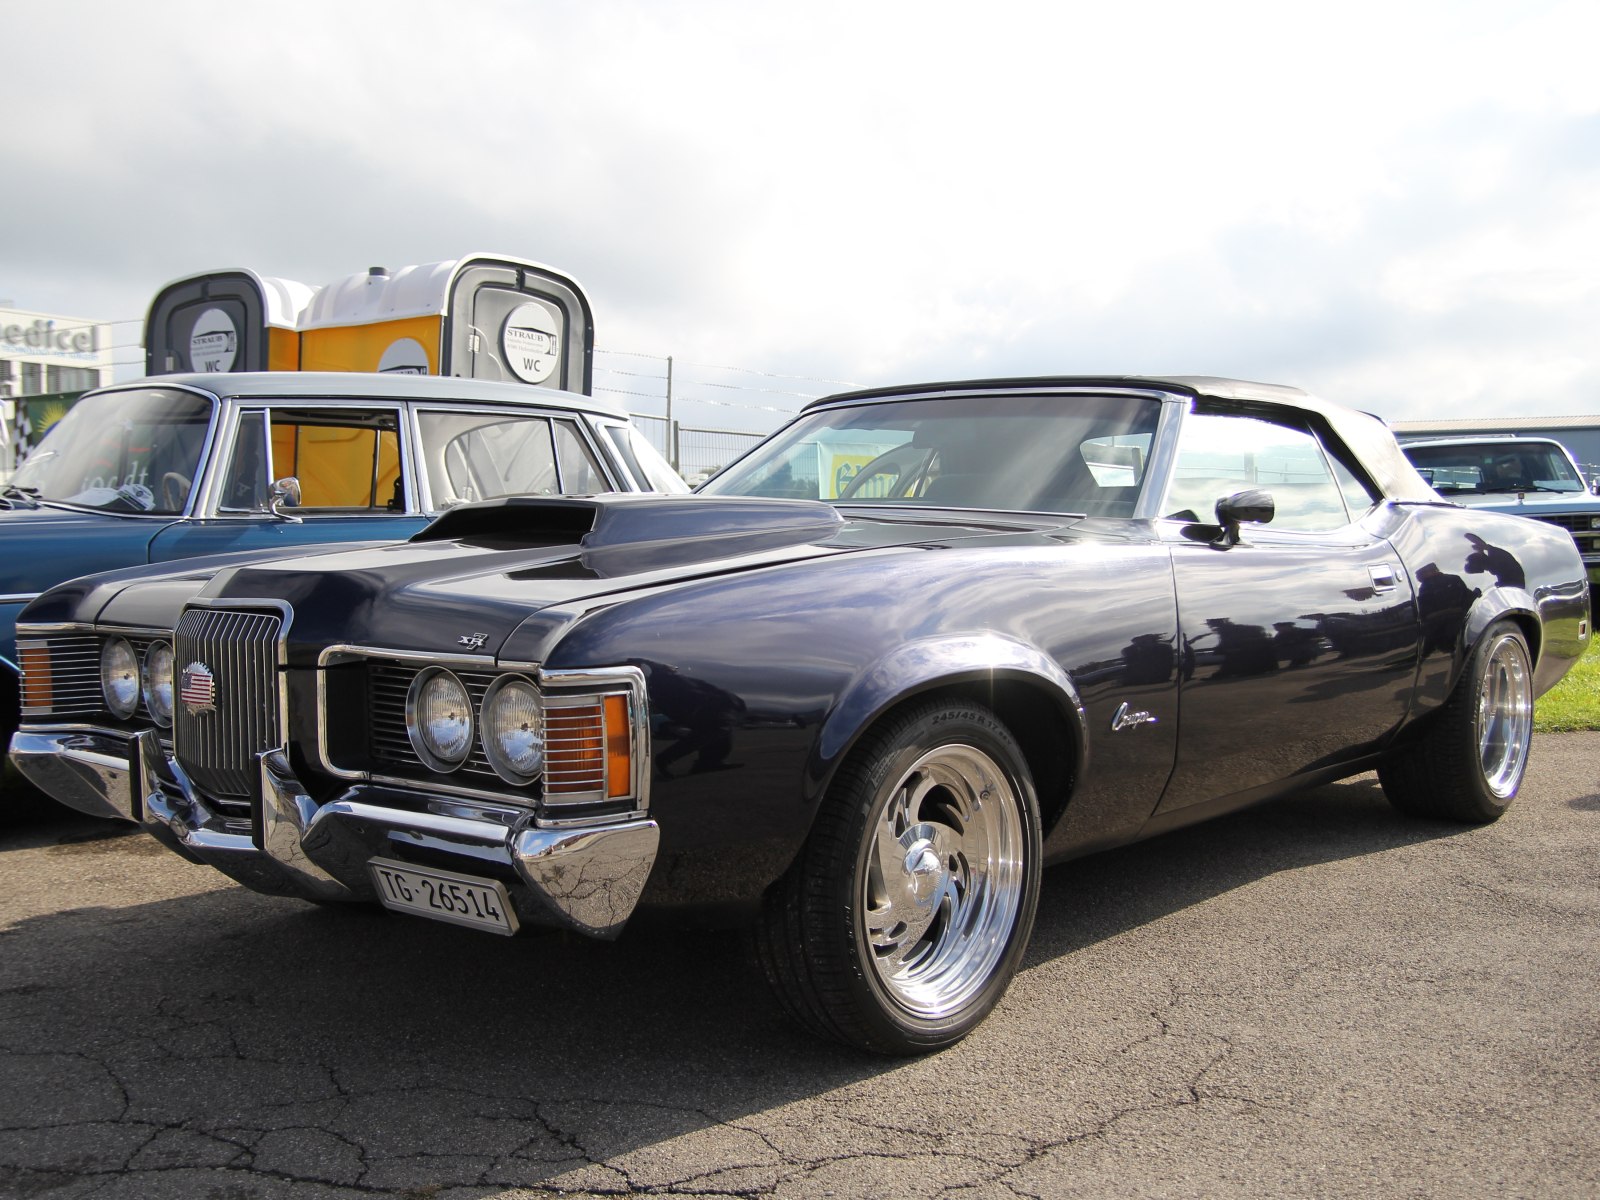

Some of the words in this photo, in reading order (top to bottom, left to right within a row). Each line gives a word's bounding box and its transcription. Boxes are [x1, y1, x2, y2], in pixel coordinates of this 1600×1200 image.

[0, 319, 99, 352] edicel
[193, 335, 223, 346] STRAUB
[507, 329, 544, 342] STRAUB
[205, 359, 221, 373] WC
[523, 357, 541, 372] WC
[932, 711, 976, 726] 245/45
[977, 715, 986, 725] R
[987, 720, 999, 731] 17
